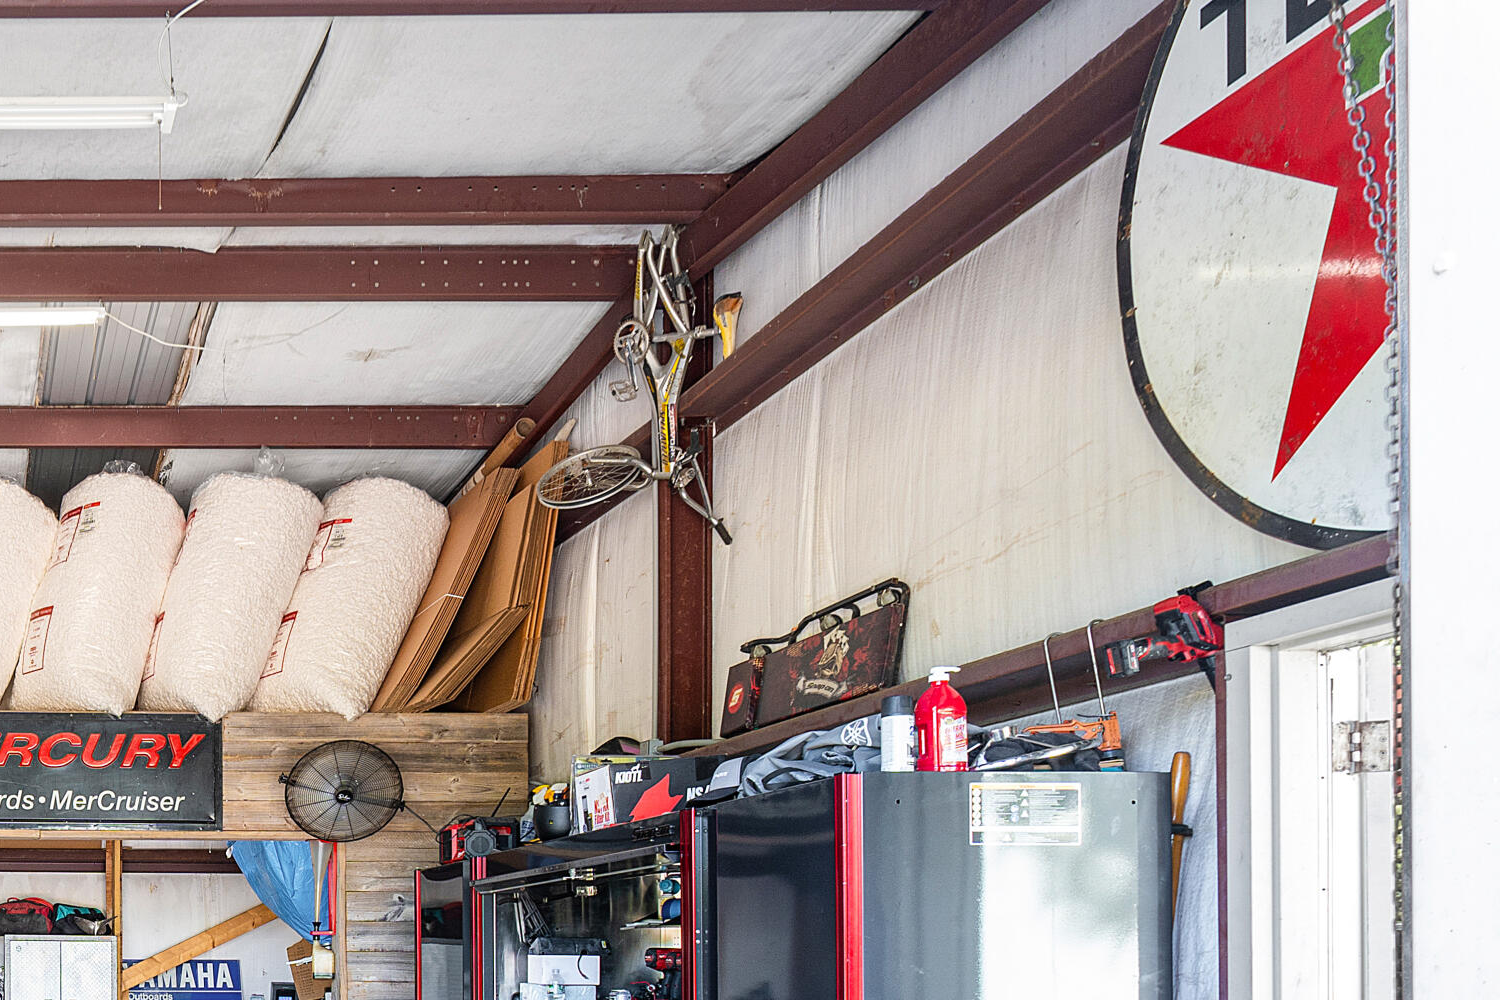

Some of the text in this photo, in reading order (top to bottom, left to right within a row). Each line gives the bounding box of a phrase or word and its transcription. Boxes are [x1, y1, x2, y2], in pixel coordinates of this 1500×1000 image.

[49, 790, 186, 812] MerCruiser
[123, 962, 234, 989] AMAHA
[128, 992, 173, 1000] Outboards
